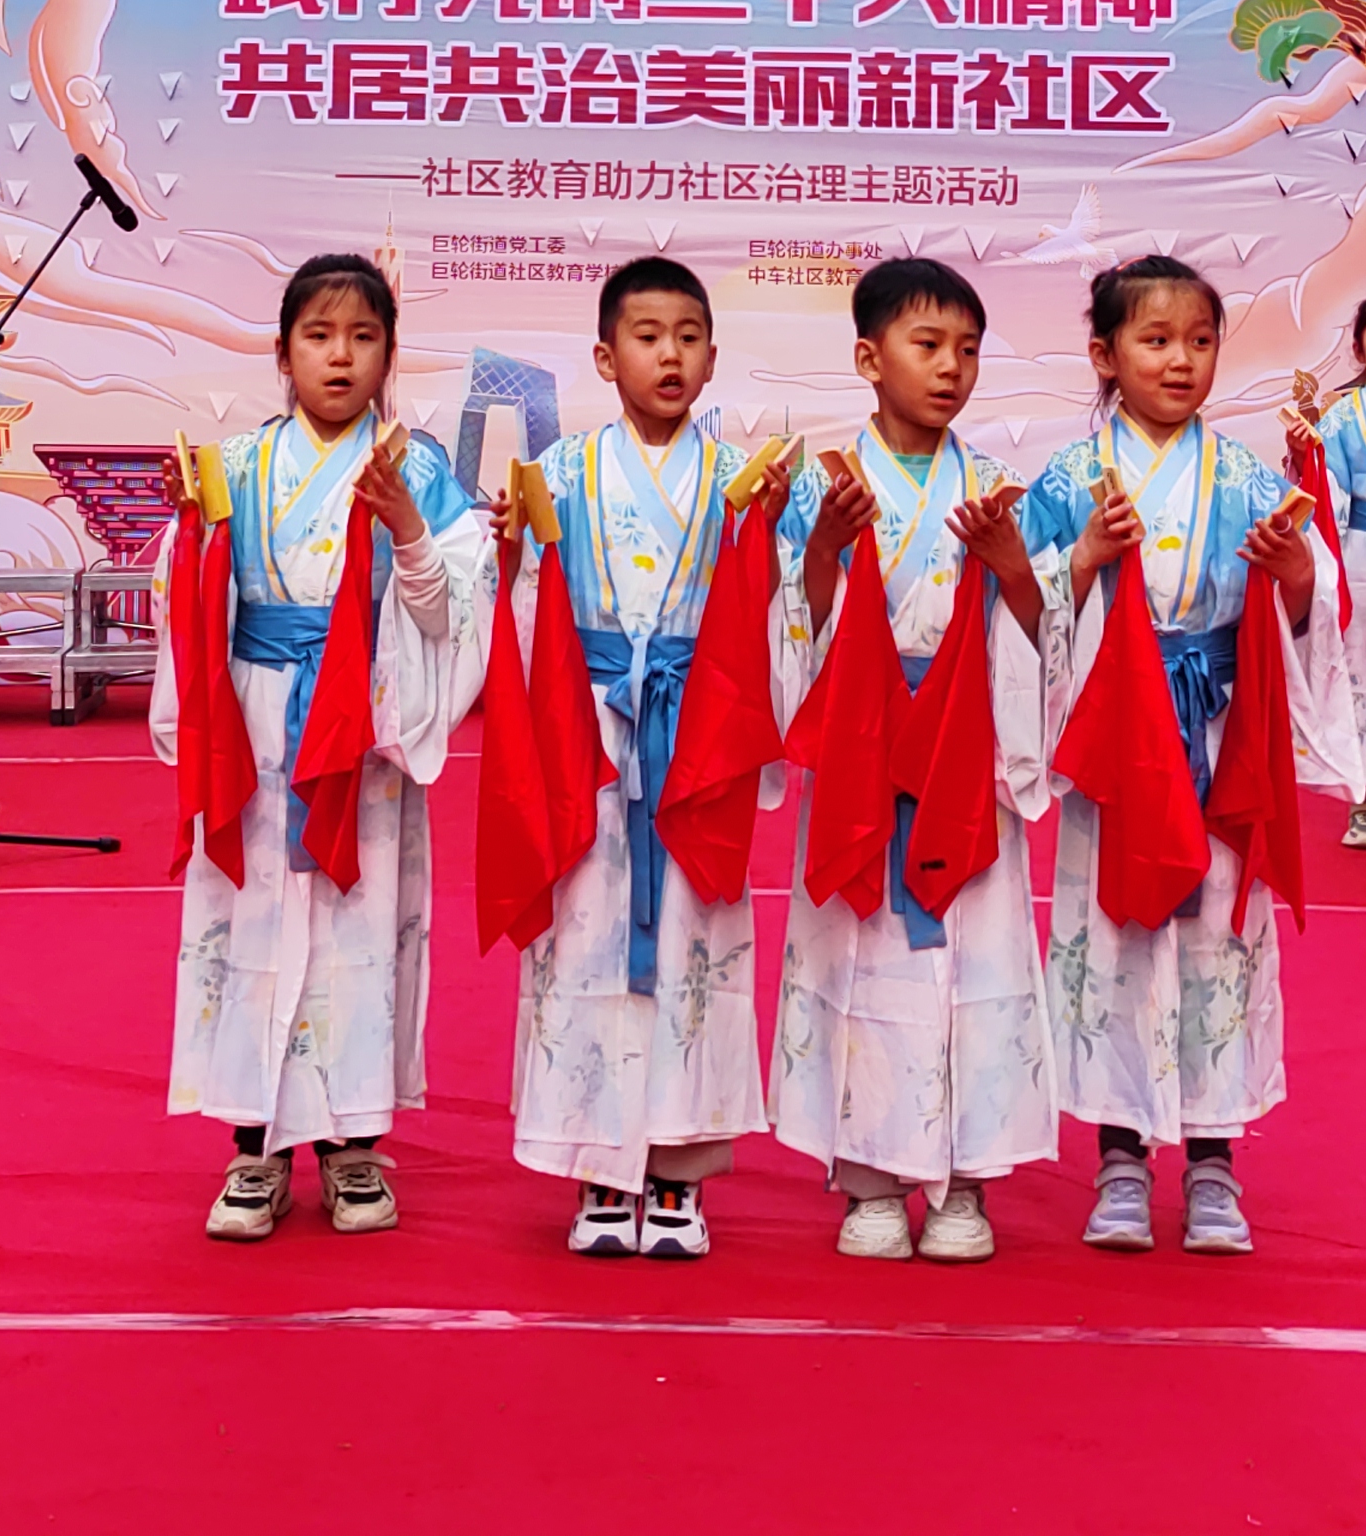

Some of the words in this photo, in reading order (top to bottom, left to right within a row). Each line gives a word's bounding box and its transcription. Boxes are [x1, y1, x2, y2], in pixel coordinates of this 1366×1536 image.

[221, 40, 1173, 132] 共居共治美丽新社区
[432, 234, 567, 255] 巨轮街道党工委
[748, 239, 883, 260] 巨轮街道办事处
